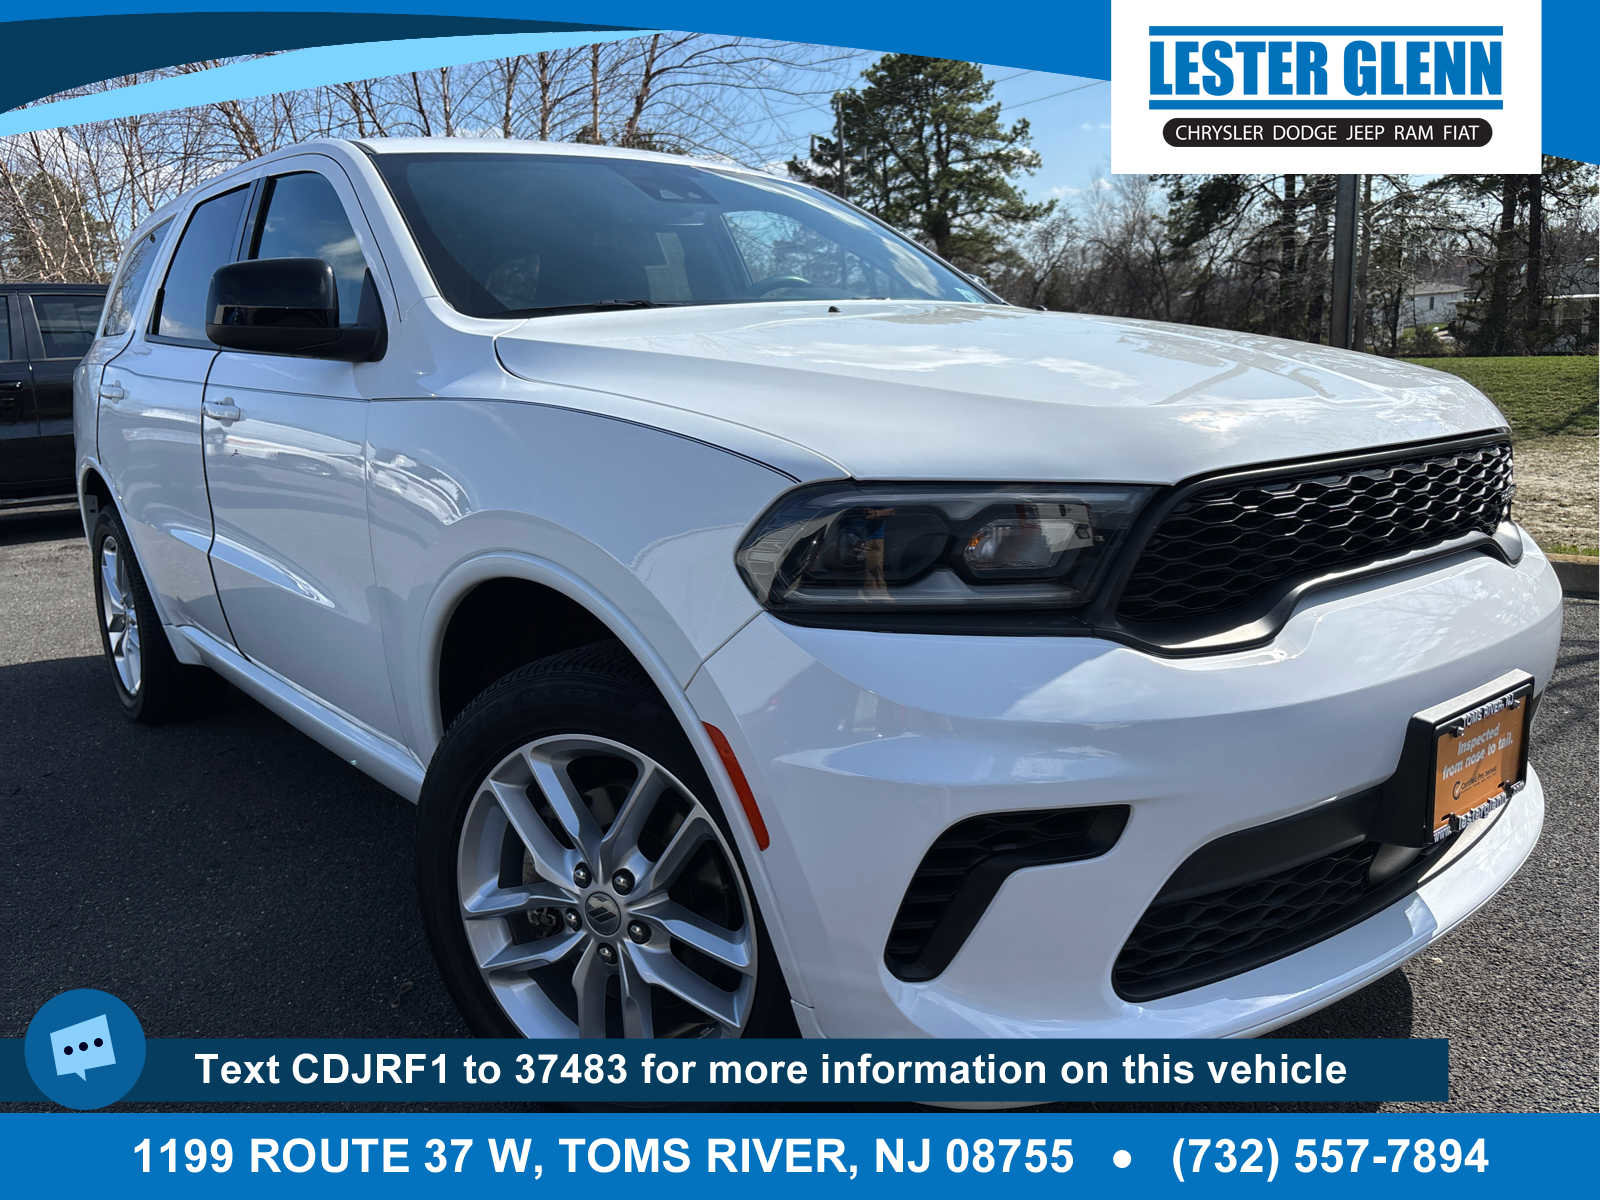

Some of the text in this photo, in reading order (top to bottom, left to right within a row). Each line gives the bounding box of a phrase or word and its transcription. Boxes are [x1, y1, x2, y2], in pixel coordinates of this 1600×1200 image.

[1463, 709, 1482, 728] TOMS
[1457, 722, 1501, 756] Inspected
[1442, 761, 1464, 780] from
[1465, 749, 1486, 768] nose
[1487, 743, 1496, 756] to
